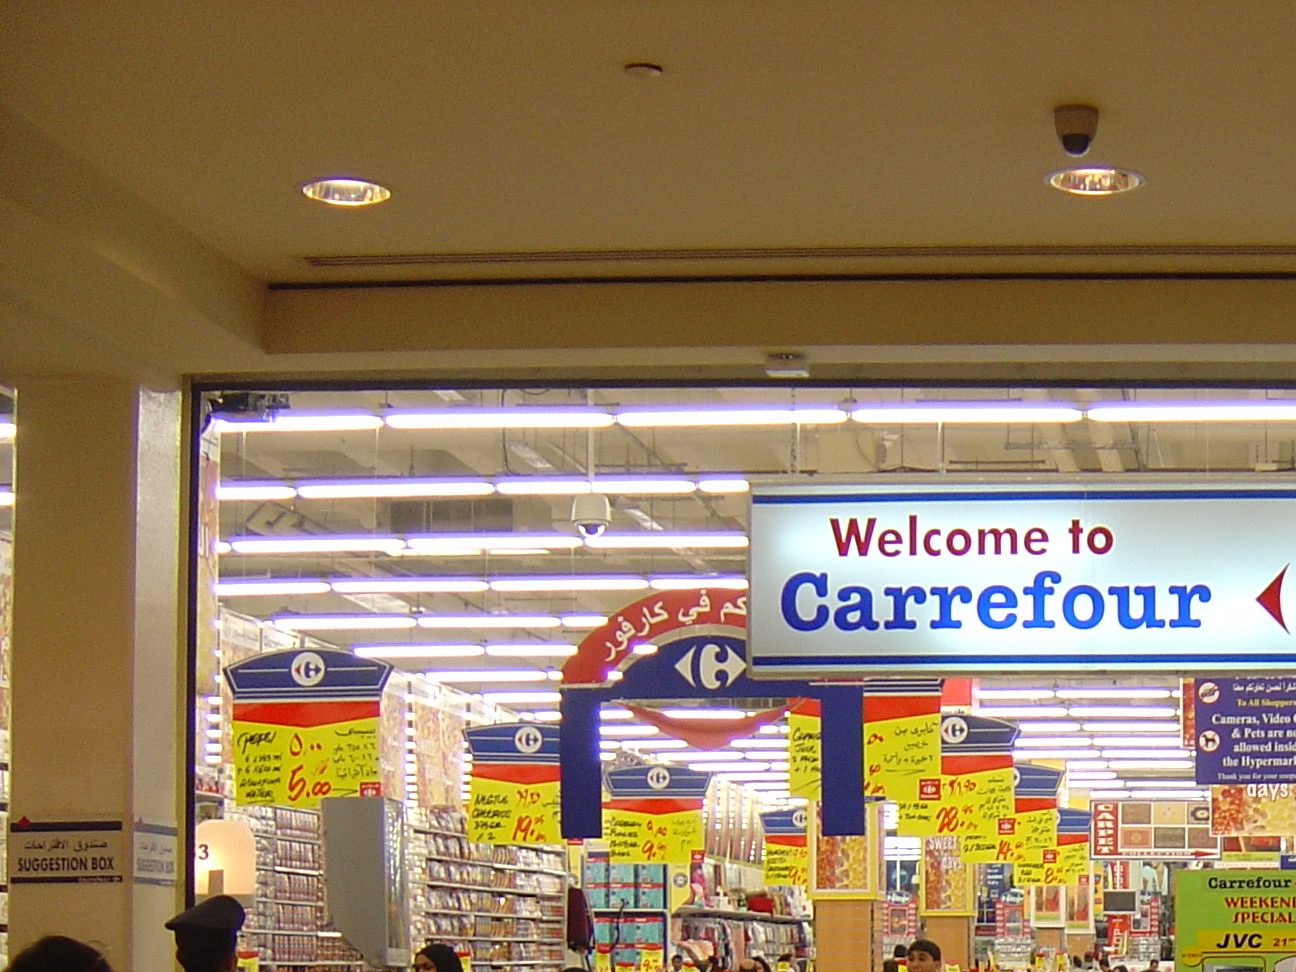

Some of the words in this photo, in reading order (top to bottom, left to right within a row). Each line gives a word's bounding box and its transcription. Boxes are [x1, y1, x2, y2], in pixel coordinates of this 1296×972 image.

[829, 515, 1049, 556] Welcome
[1068, 519, 1114, 555] to
[678, 589, 710, 624] في
[780, 570, 1212, 631] Carrefour
[605, 601, 669, 662] كارفور
[1261, 700, 1296, 708] Shoppers
[1211, 714, 1260, 724] Cameras,
[1262, 713, 1291, 724] Video
[1231, 728, 1240, 738] &
[1244, 728, 1265, 738] Pets
[1267, 730, 1284, 738] are
[1233, 742, 1272, 752] allowed
[1223, 757, 1238, 767] the
[199, 844, 209, 860] 3
[18, 857, 88, 872] SUGGESTION
[91, 856, 114, 871] BOX
[1208, 877, 1292, 889] Carrefour
[1232, 911, 1296, 924] SPECIAL
[1216, 933, 1263, 949] JVC
